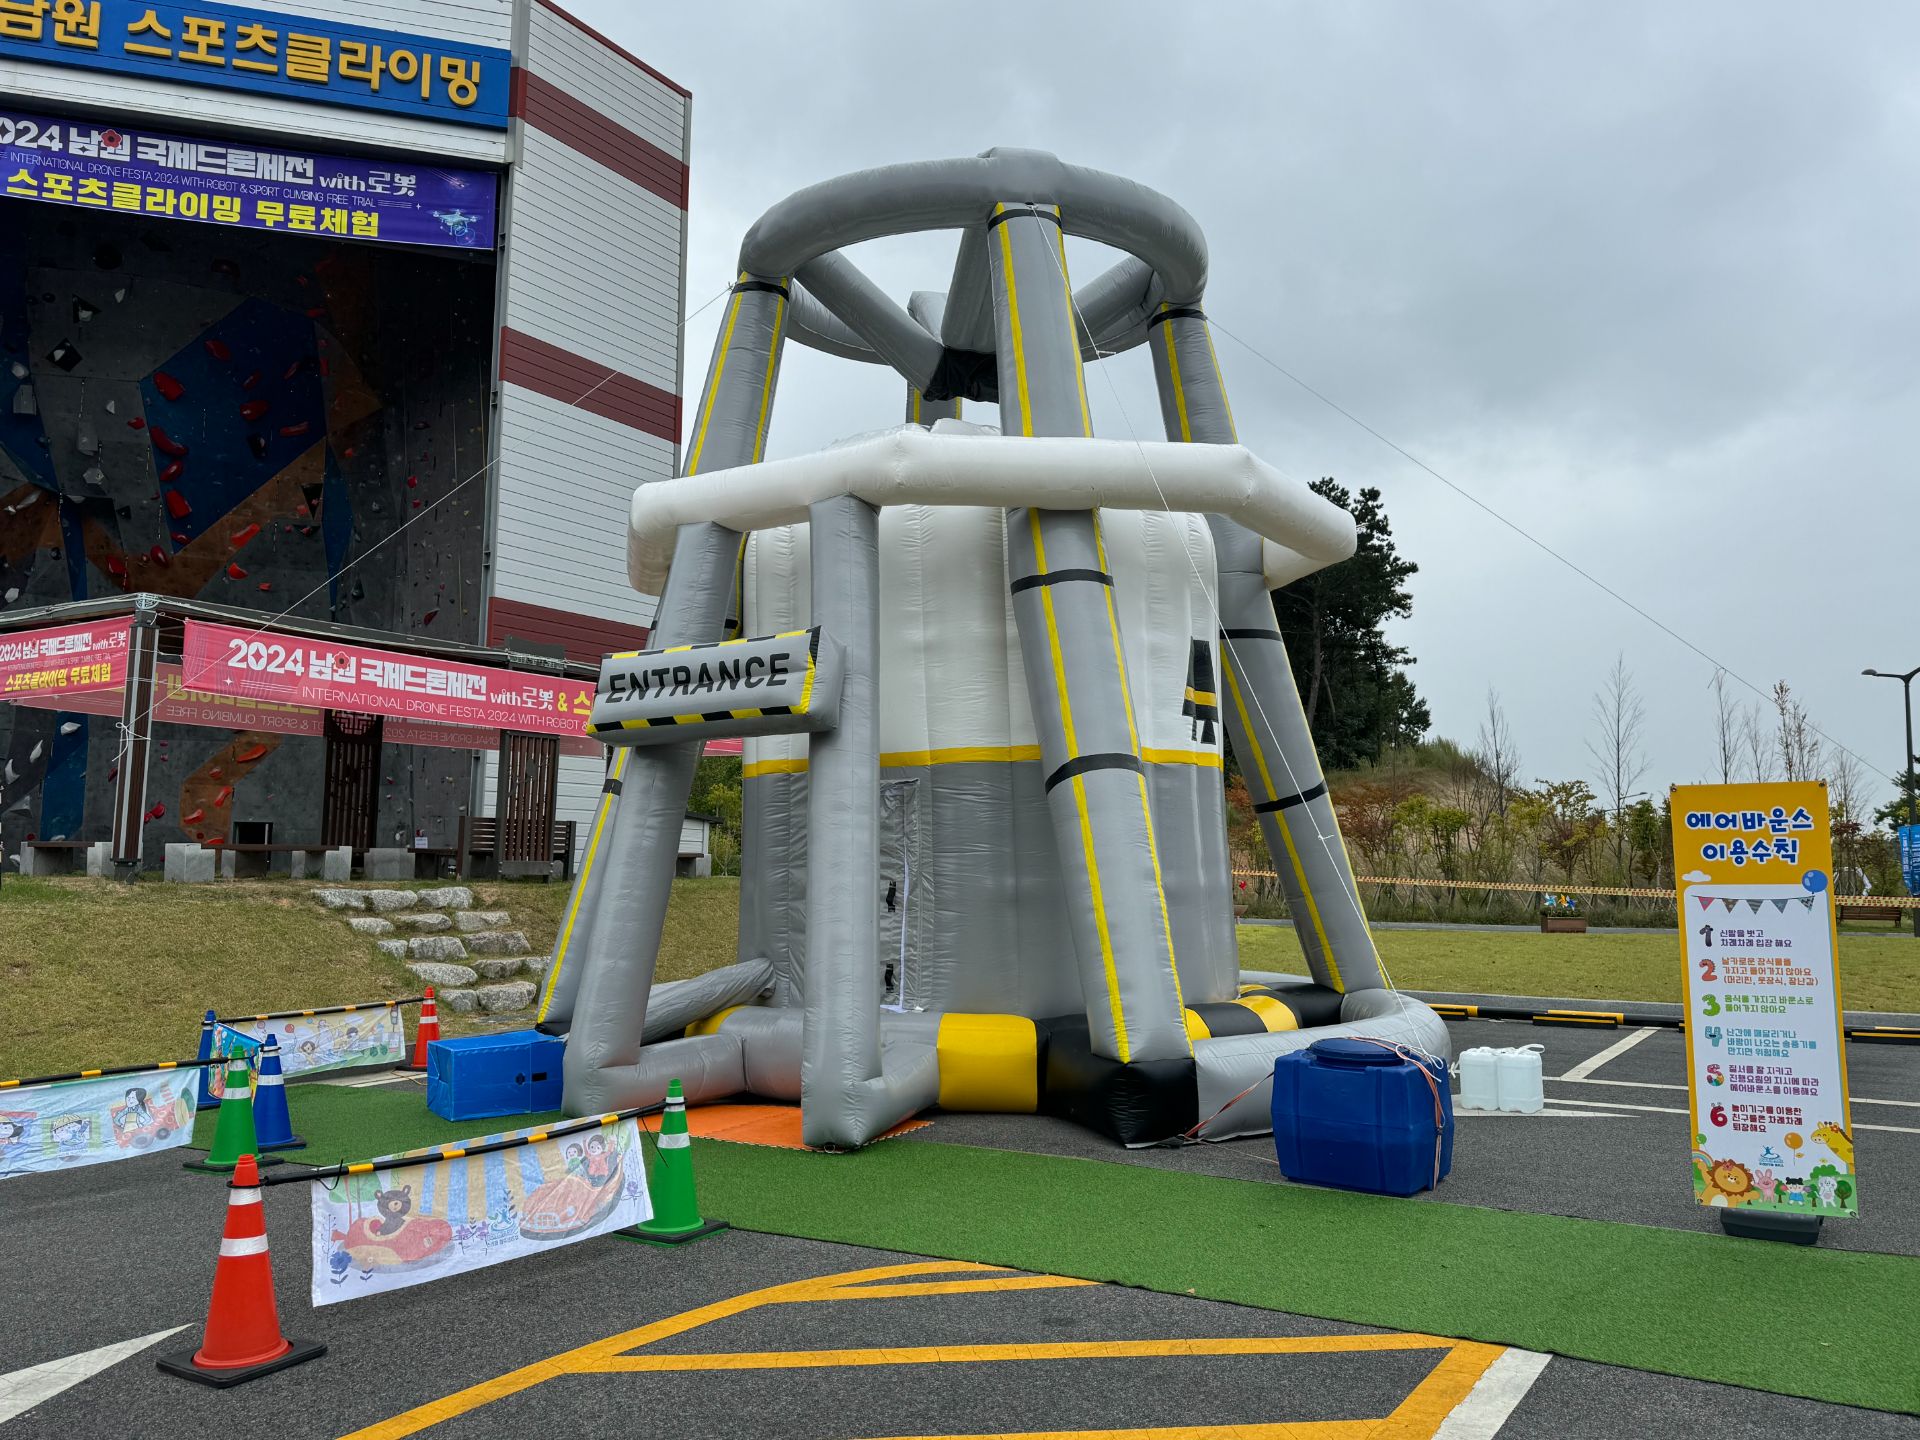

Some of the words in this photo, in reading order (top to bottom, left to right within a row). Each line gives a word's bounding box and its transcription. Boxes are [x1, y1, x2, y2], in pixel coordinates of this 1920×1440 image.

[124, 9, 480, 107] 스포츠클라이밍
[69, 127, 131, 162] 남원
[137, 136, 314, 185] 국제드론제전
[10, 151, 86, 172] INTERNATIONAL
[88, 162, 121, 177] DRONE
[122, 167, 153, 181] FESTA
[154, 172, 179, 184] 2024
[181, 176, 205, 188] WITH
[206, 179, 239, 192] ROBOT
[240, 183, 248, 193] &
[248, 184, 280, 197] SPORT
[282, 188, 324, 202] CLIMBING
[326, 193, 349, 205] FREE
[352, 196, 377, 208] TRIAL
[6, 168, 241, 223] 스포츠클라이밍
[255, 200, 379, 238] 무료체험
[4, 667, 69, 692] 스포츠클라이밍
[70, 662, 111, 686] 무료체험
[228, 638, 305, 677] 2024
[308, 650, 357, 684] 남원
[360, 657, 487, 701] 국제드론제전
[557, 691, 568, 712] &
[605, 652, 790, 704] ENTRANCE
[302, 685, 404, 710] INTERNATIONAL
[406, 699, 447, 715] DRONE
[449, 704, 486, 719] FESTA
[487, 709, 516, 723] 2024
[518, 712, 545, 726] WITH
[546, 715, 581, 731] ROBOT
[1686, 806, 1814, 834] 에어바운스
[1702, 838, 1799, 866] 이용수칙
[1720, 929, 1745, 938] 신발을
[1746, 929, 1764, 938] 벗고
[1720, 938, 1754, 947] 차례차례
[1756, 938, 1773, 948] 입장
[1775, 939, 1793, 948] 해요
[1699, 958, 1718, 982] 2
[1721, 957, 1756, 966] 날카로운
[1722, 966, 1747, 975] 가지고
[1750, 966, 1784, 976] 들어가지
[1785, 967, 1812, 976] 않아요
[1788, 976, 1819, 986] 장난감)
[1701, 993, 1721, 1017] 3
[1724, 994, 1750, 1003] 음식을
[1752, 995, 1777, 1004] 가지고
[1779, 996, 1814, 1005] 바운스로
[1725, 1003, 1759, 1013] 들어가지
[1760, 1004, 1787, 1014] 않아요
[1726, 1027, 1752, 1037] 난간에
[1753, 1028, 1797, 1039] 매달리거나
[1727, 1038, 1752, 1047] 바람이
[1754, 1039, 1780, 1048] 나오는
[1782, 1040, 1817, 1050] 송풍기를
[1727, 1047, 1753, 1056] 만지면
[1755, 1048, 1790, 1058] 위험해요
[1706, 1063, 1725, 1087] 5
[1728, 1064, 1754, 1074] 질서를
[1756, 1065, 1764, 1075] 잘
[1766, 1066, 1793, 1076] 지키고
[1729, 1073, 1772, 1084] 진행요원의
[1774, 1075, 1800, 1086] 지시에
[1801, 1077, 1819, 1087] 따라
[1729, 1083, 1781, 1095] 에어바운스를
[1783, 1086, 1819, 1096] 이용해요
[1710, 1103, 1728, 1128] 6
[1731, 1104, 1774, 1115] 놀이기구를
[1775, 1106, 1802, 1117] 이용한
[1731, 1113, 1766, 1124] 친구들은
[1768, 1115, 1803, 1126] 차례차례
[1732, 1122, 1767, 1133] 퇴장해요
